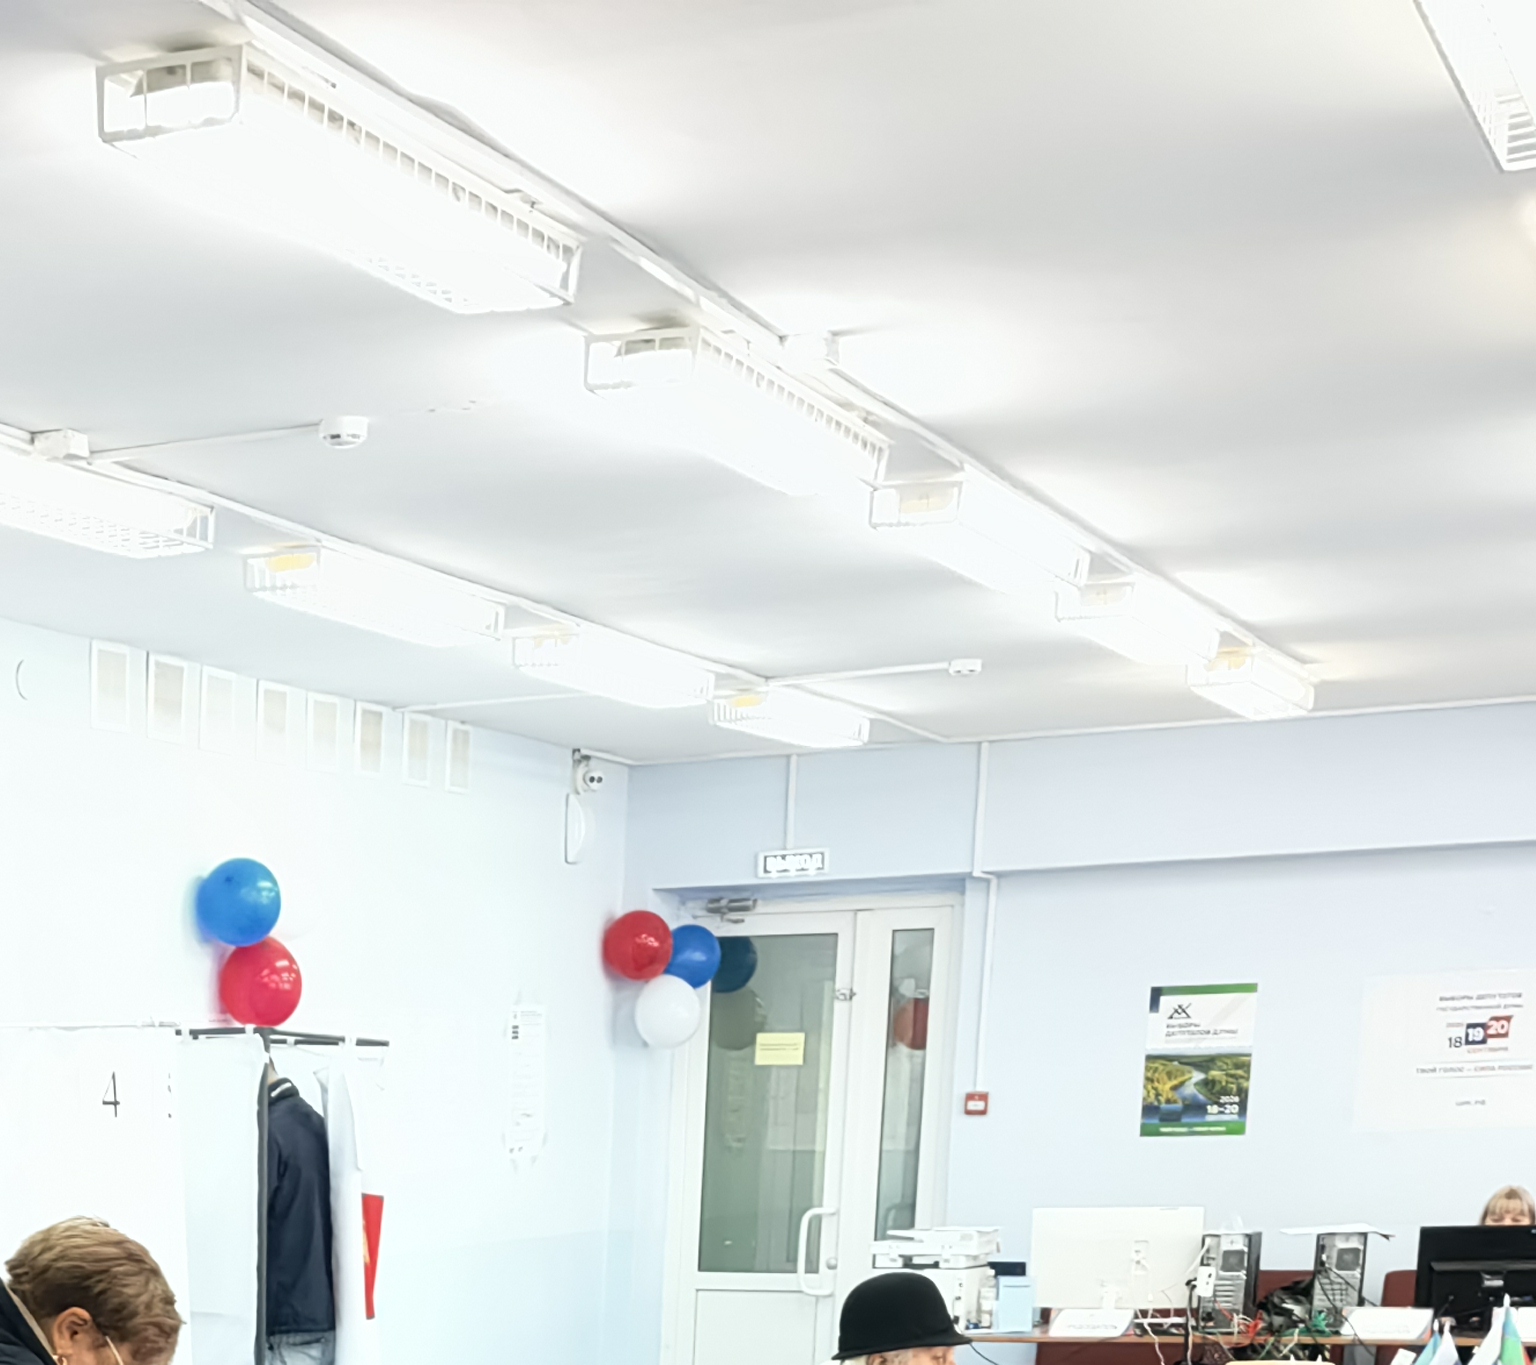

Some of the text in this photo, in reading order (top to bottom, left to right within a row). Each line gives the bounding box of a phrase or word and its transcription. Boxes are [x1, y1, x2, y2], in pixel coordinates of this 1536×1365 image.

[1448, 1020, 1509, 1048] 18 19 20
[102, 1071, 120, 1118] 4
